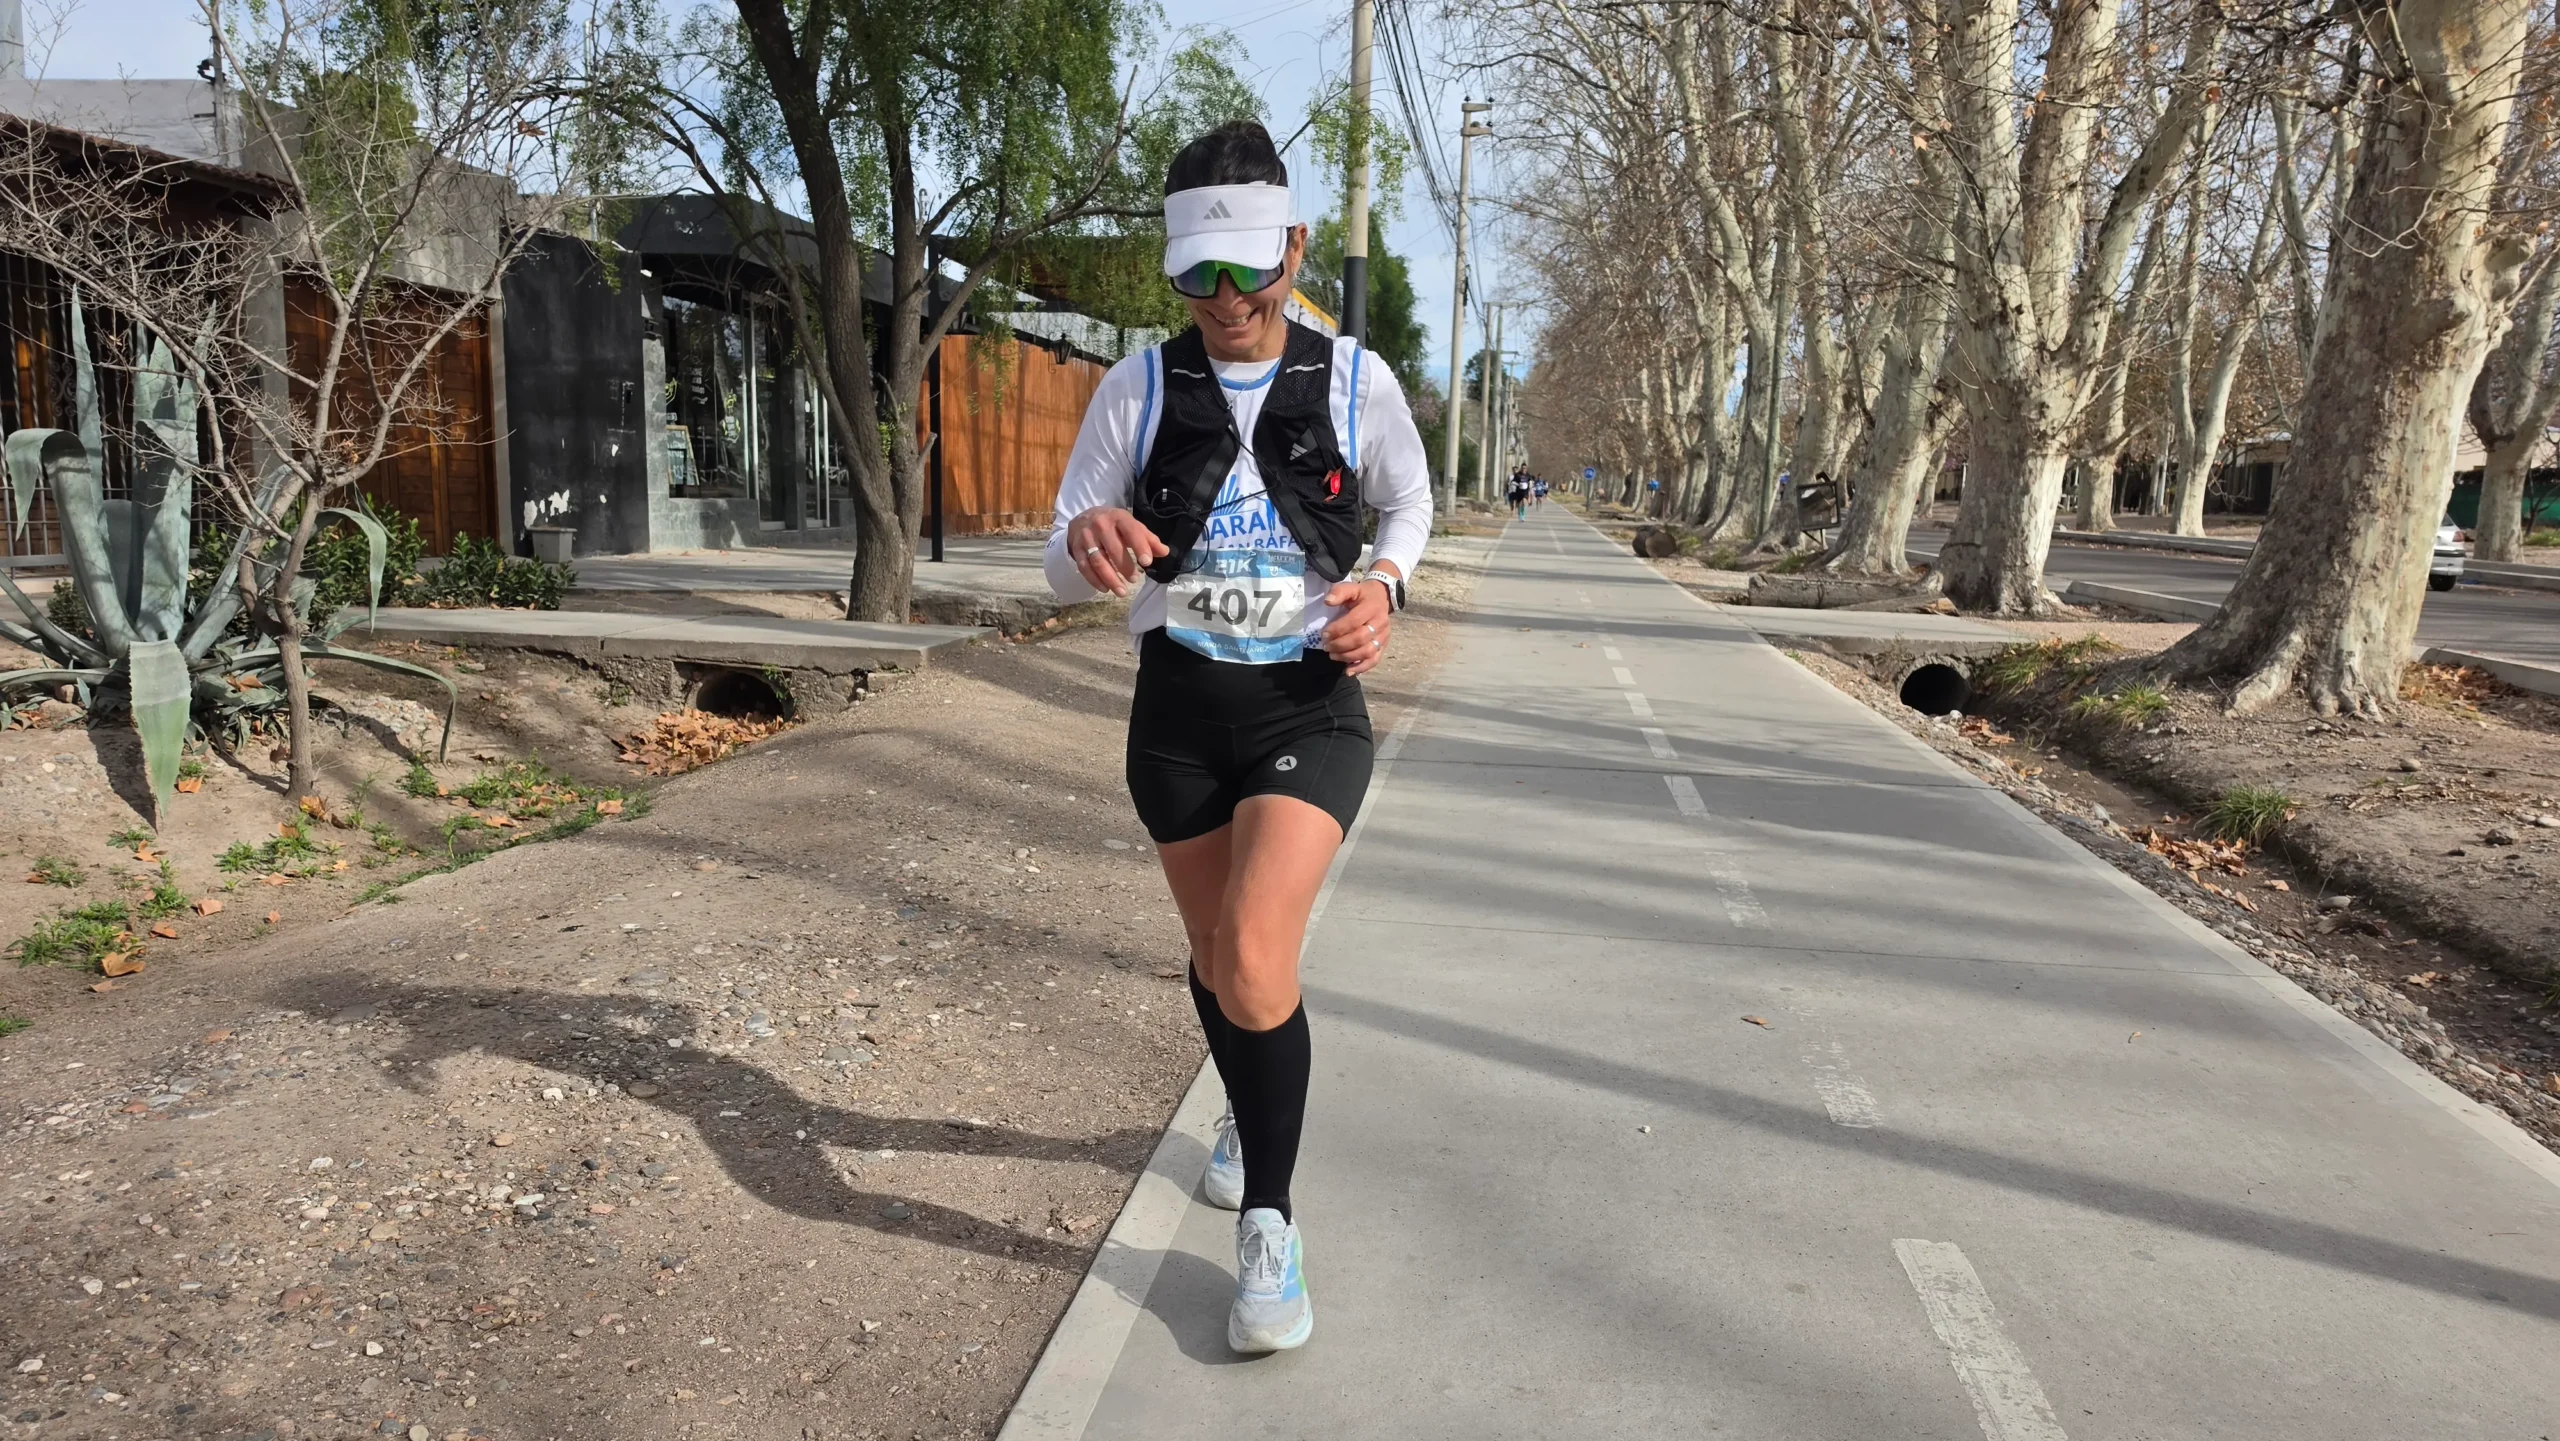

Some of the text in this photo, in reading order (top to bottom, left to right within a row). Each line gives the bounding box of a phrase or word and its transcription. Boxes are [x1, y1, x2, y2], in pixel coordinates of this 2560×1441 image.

[1254, 536, 1296, 549] RAFA
[1214, 557, 1253, 574] 21K
[1187, 587, 1282, 627] 407
